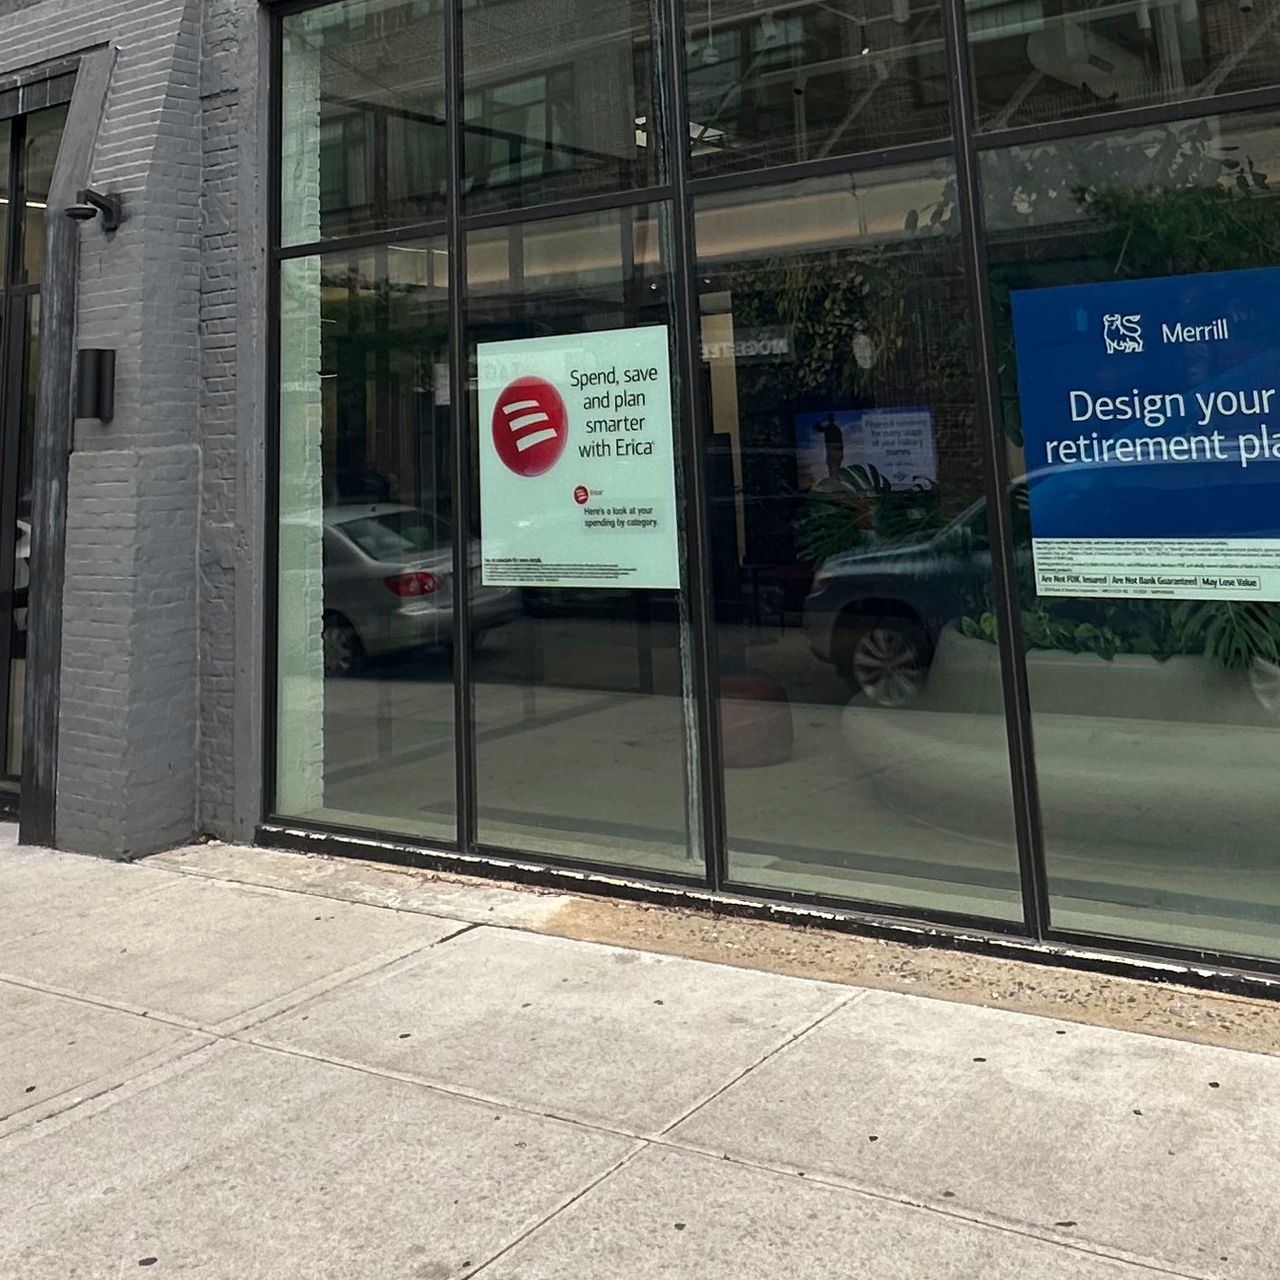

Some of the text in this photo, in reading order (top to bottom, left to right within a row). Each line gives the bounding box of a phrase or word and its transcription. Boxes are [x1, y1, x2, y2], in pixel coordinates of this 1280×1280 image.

[1161, 318, 1229, 343] Merrill
[570, 365, 619, 391] Spend,
[623, 367, 658, 383] save
[583, 389, 646, 412] and plan
[1069, 387, 1276, 428] Design your
[585, 415, 646, 434] smarter
[578, 438, 611, 458] with
[1045, 429, 1229, 463] retirement
[584, 507, 605, 516] Here's
[612, 506, 627, 515] look
[629, 507, 636, 515] at
[637, 507, 653, 517] your
[584, 519, 616, 529] spending
[616, 518, 625, 528] by
[1041, 575, 1053, 584] Are
[1053, 575, 1065, 584] Not
[1082, 575, 1107, 585] Insured
[1112, 576, 1197, 586] Are Not Bank Guaranteed
[1202, 578, 1257, 588] May Lose Value
